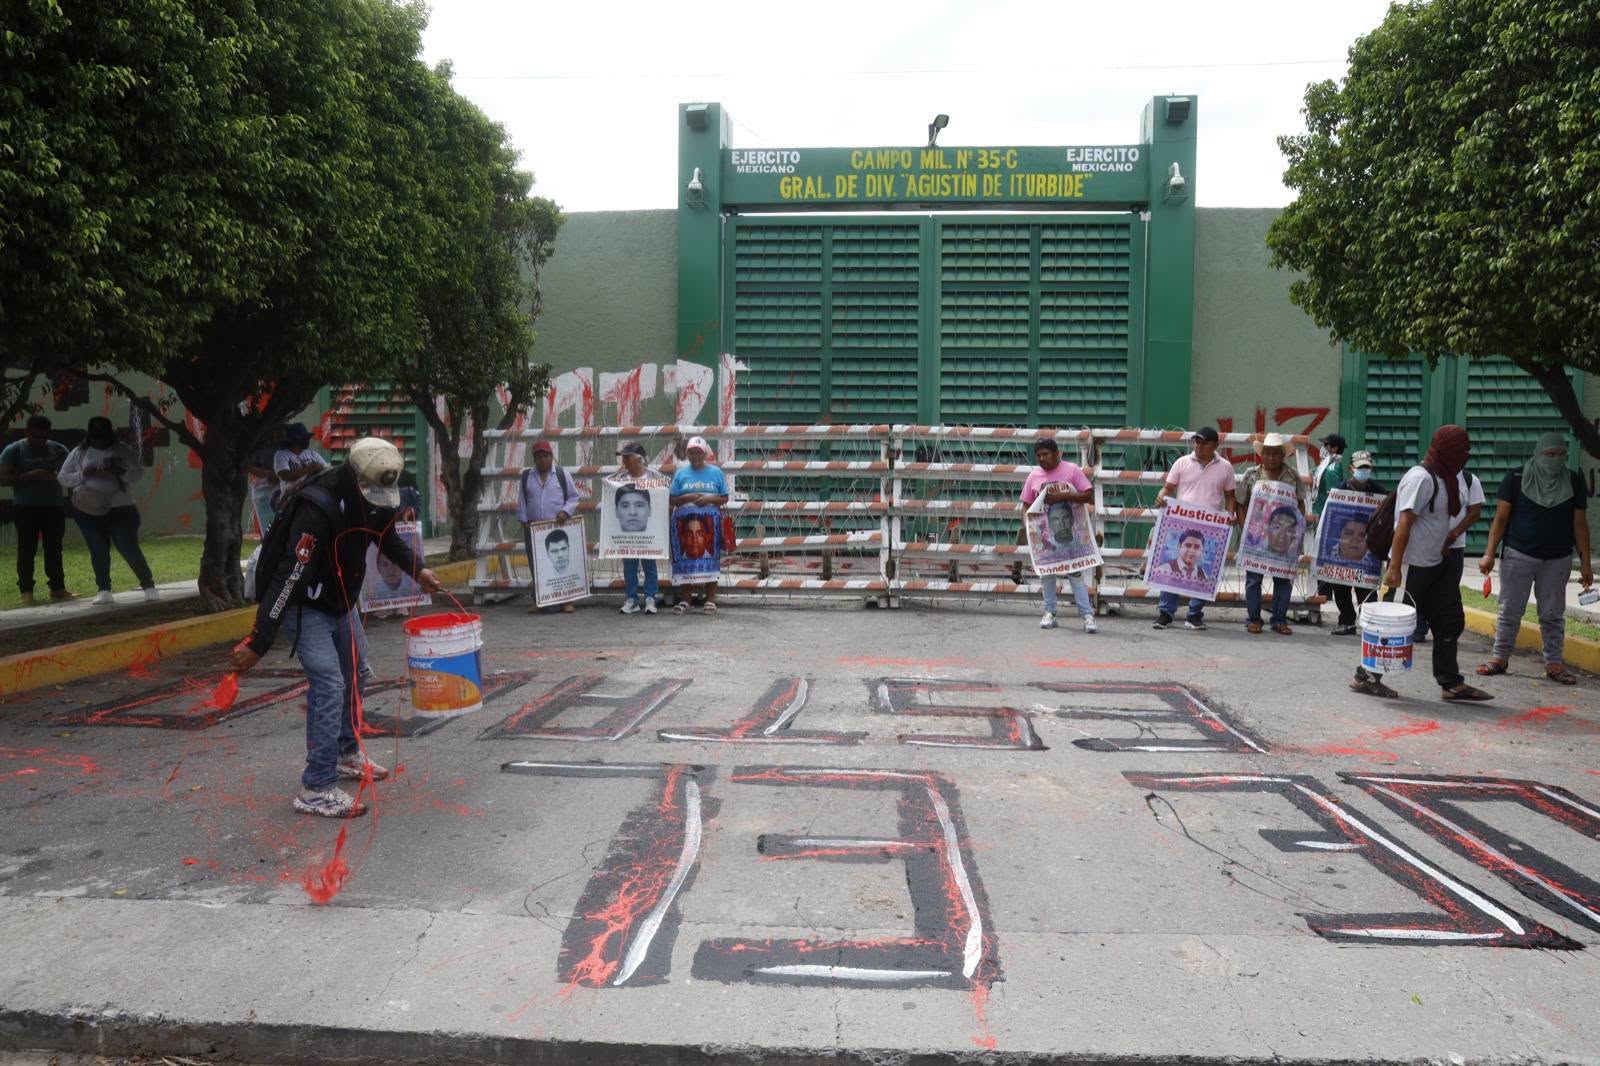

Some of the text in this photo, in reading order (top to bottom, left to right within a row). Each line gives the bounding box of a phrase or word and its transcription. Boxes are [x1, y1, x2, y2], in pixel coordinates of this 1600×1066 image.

[731, 151, 800, 165] EJERCITO
[851, 150, 912, 169] CAMPO
[920, 150, 952, 169] MIL.
[978, 149, 1018, 169] 35-C
[1066, 148, 1140, 162] EJERCITO
[736, 165, 796, 173] MEXICANO
[1072, 163, 1133, 172] MEXICANO
[780, 176, 831, 199] GRAL.
[835, 175, 858, 198] DE
[866, 174, 897, 198] DIV.
[983, 174, 1002, 196] DE
